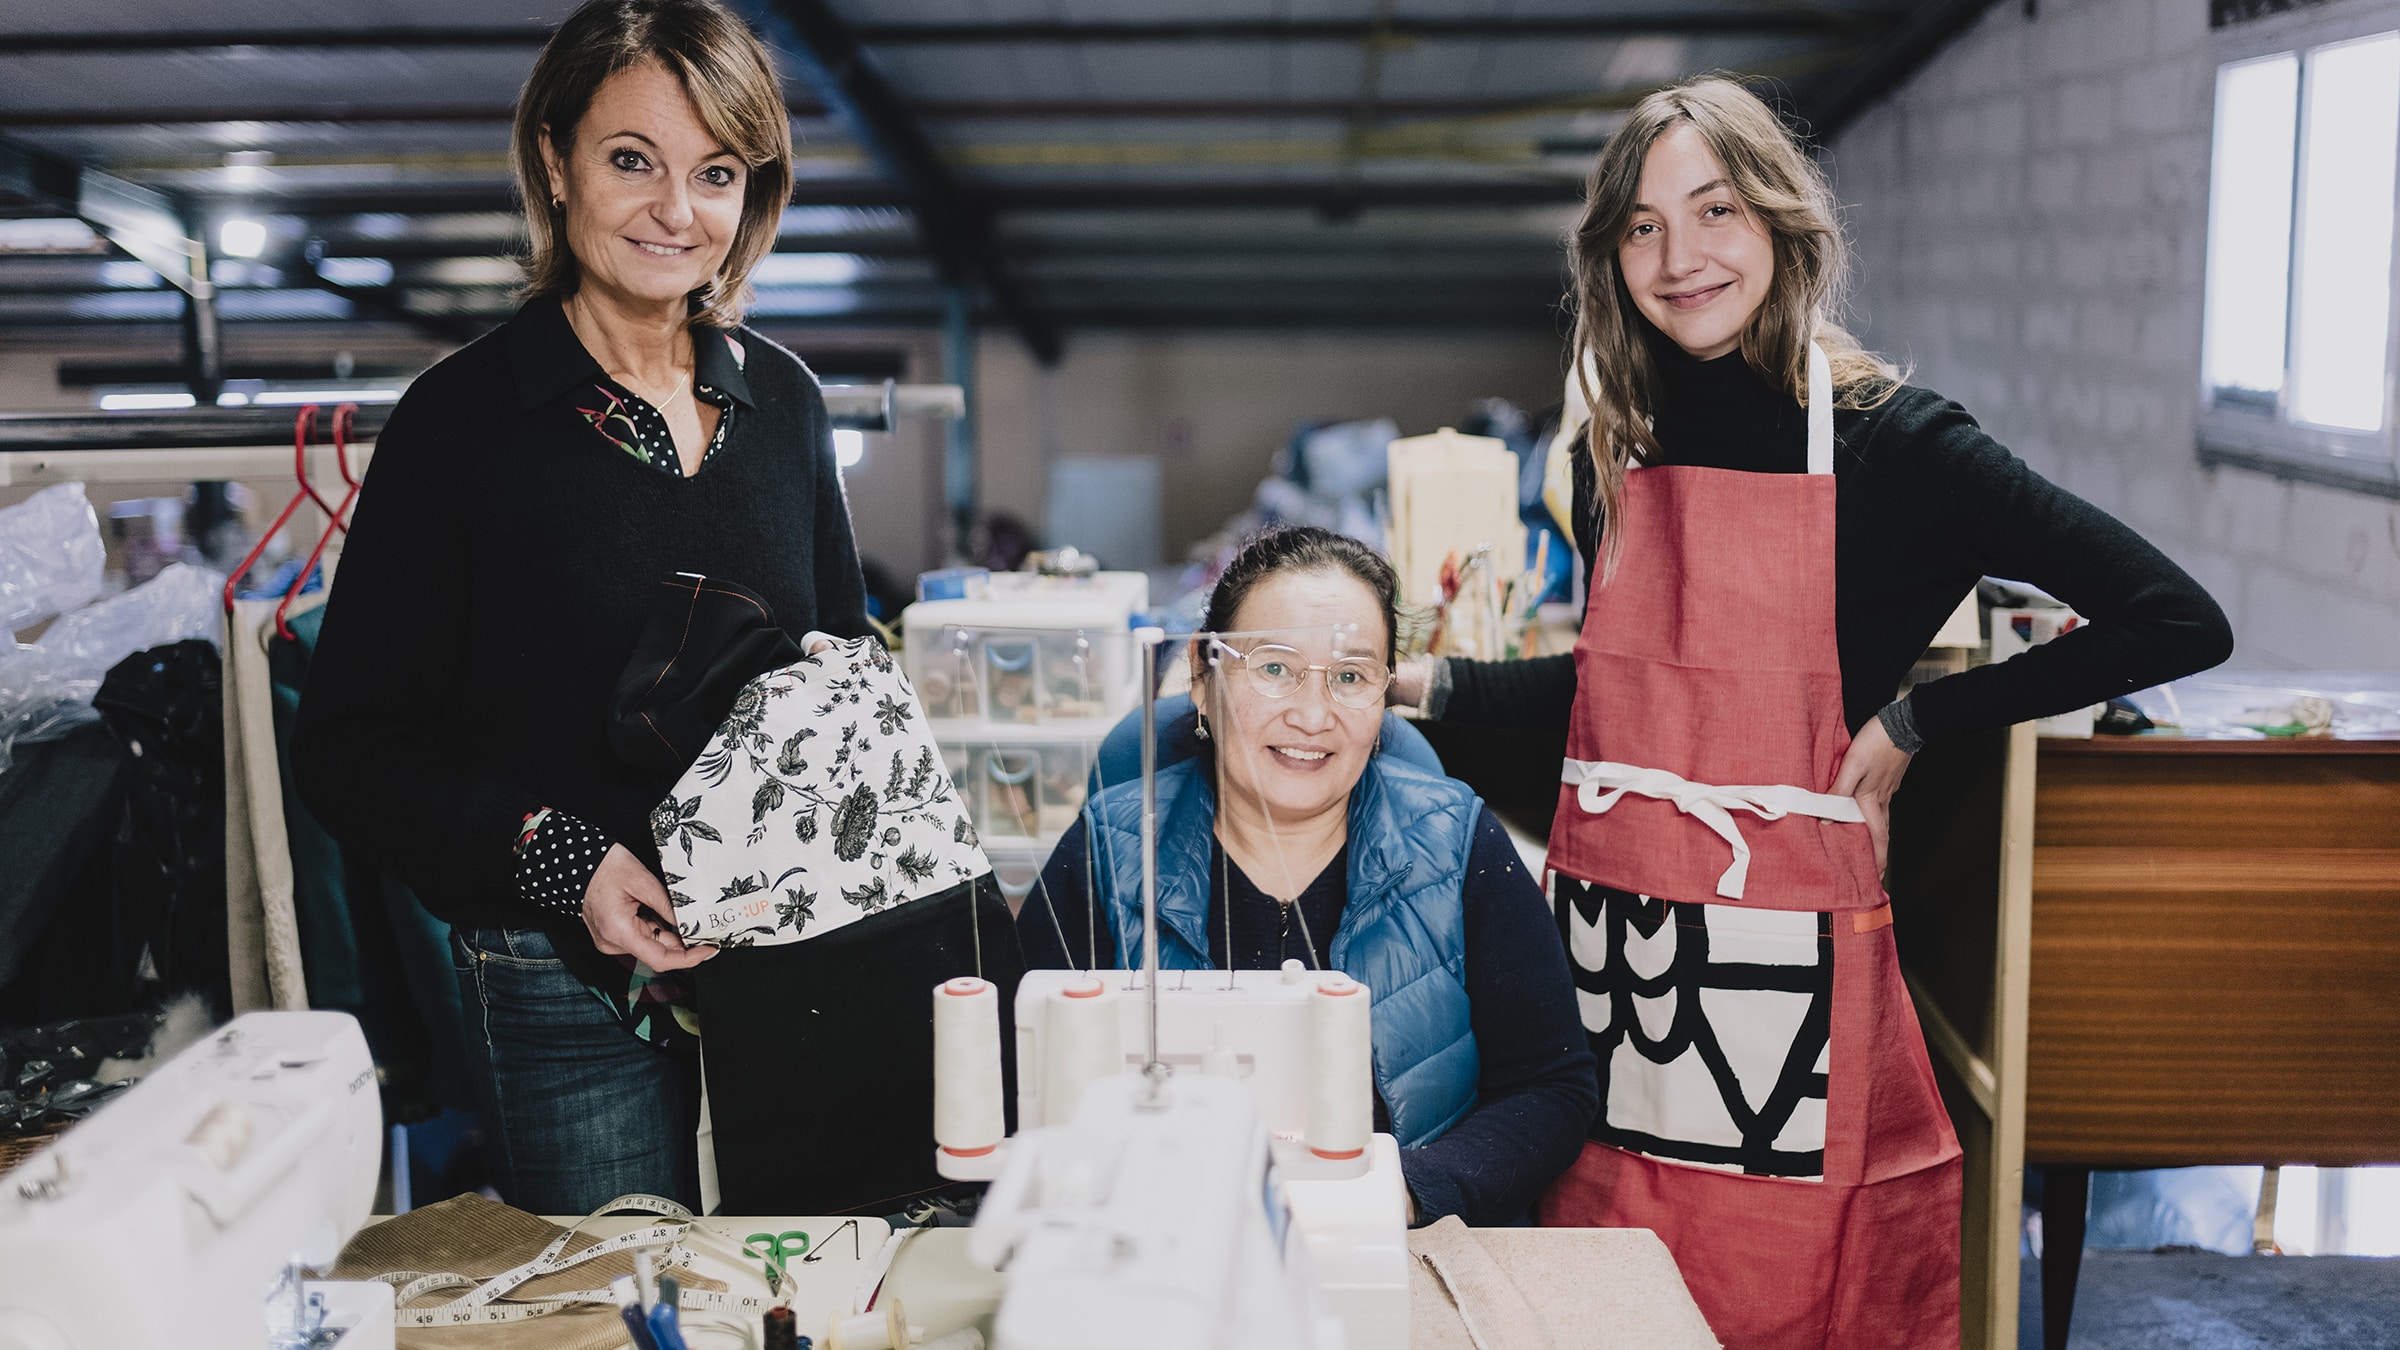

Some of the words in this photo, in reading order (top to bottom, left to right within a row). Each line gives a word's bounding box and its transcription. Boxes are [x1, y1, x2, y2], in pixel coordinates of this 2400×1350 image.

[653, 1228, 666, 1237] 37
[619, 1233, 636, 1243] 38
[486, 1287, 501, 1299] 25
[526, 1266, 538, 1275] 27
[543, 1251, 556, 1264] 28
[708, 1293, 723, 1303] 11
[742, 1297, 759, 1306] 10
[416, 1315, 433, 1324] 49
[453, 1313, 470, 1322] 50
[490, 1311, 506, 1320] 51
[526, 1308, 543, 1317] 52
